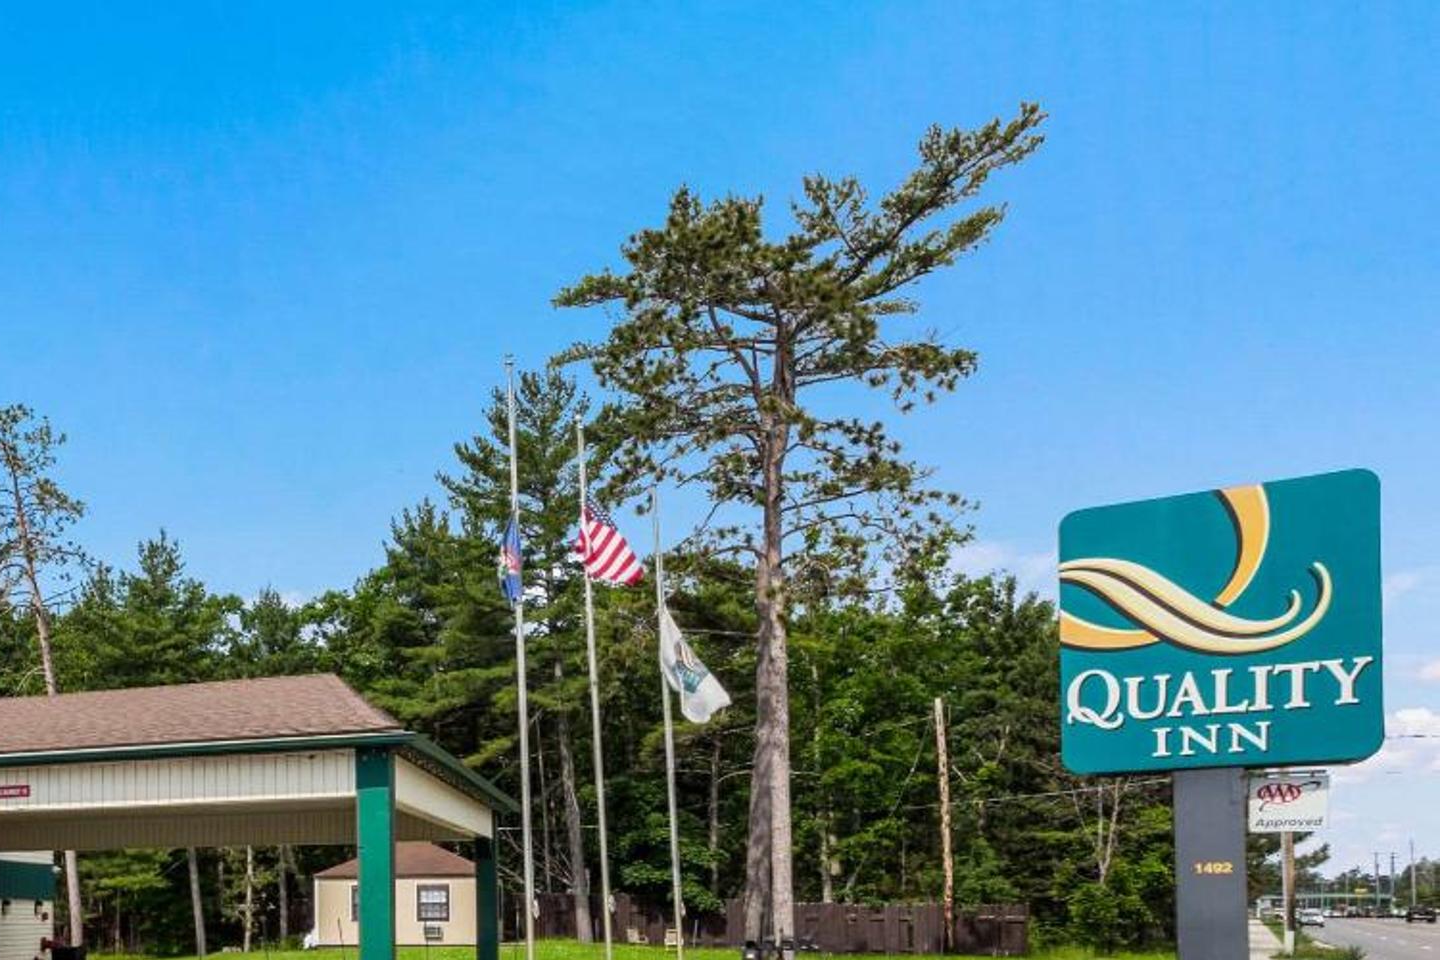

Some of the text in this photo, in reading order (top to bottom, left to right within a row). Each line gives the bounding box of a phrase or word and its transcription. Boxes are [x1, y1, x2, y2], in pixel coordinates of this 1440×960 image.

[1067, 656, 1372, 729] QUALITY
[1152, 721, 1271, 757] INN
[1258, 783, 1301, 801] AAA
[1255, 816, 1323, 828] Approved
[1194, 862, 1233, 874] 1492
